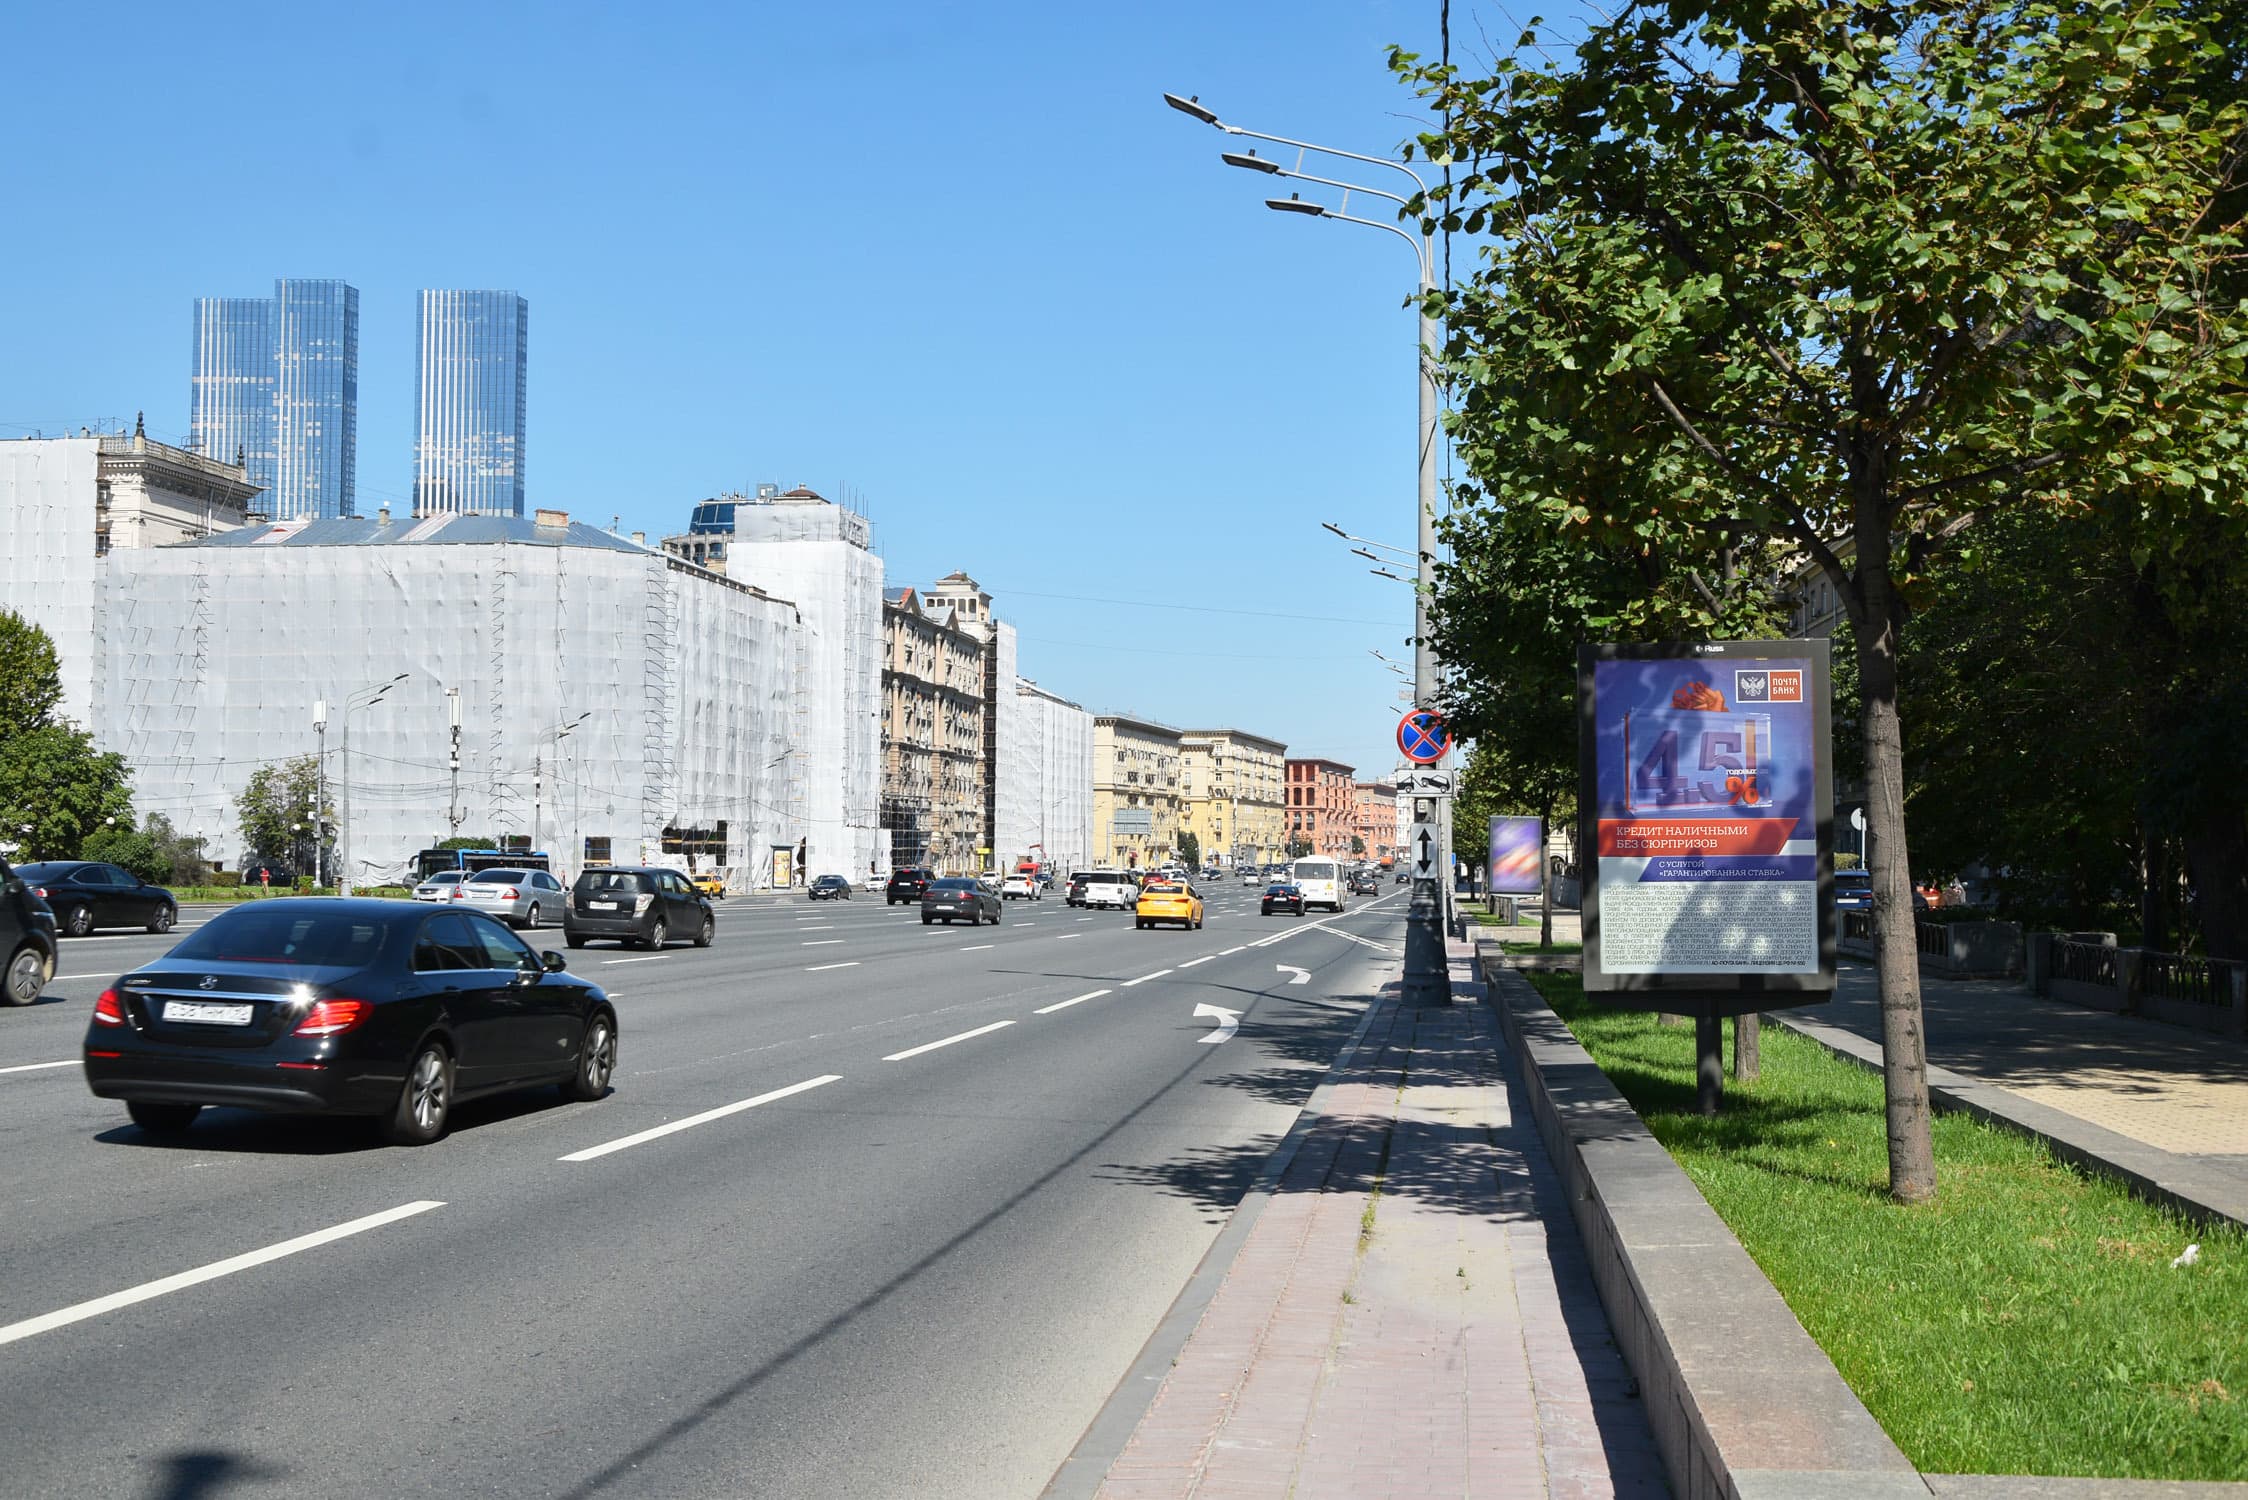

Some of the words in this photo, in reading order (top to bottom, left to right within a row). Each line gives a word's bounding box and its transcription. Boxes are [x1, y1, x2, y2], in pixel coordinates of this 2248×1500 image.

[1772, 678, 1798, 686] ПОЧТА
[1772, 687, 1795, 695] БАНК
[1616, 827, 1664, 837] КРЕДИТ
[1666, 826, 1748, 836] НАЛИЧНЫМИ
[1616, 839, 1638, 849] БЕЗ
[1641, 839, 1718, 849] СЮРПРИЗОВ
[1666, 859, 1705, 868] УСЛУГОЙ
